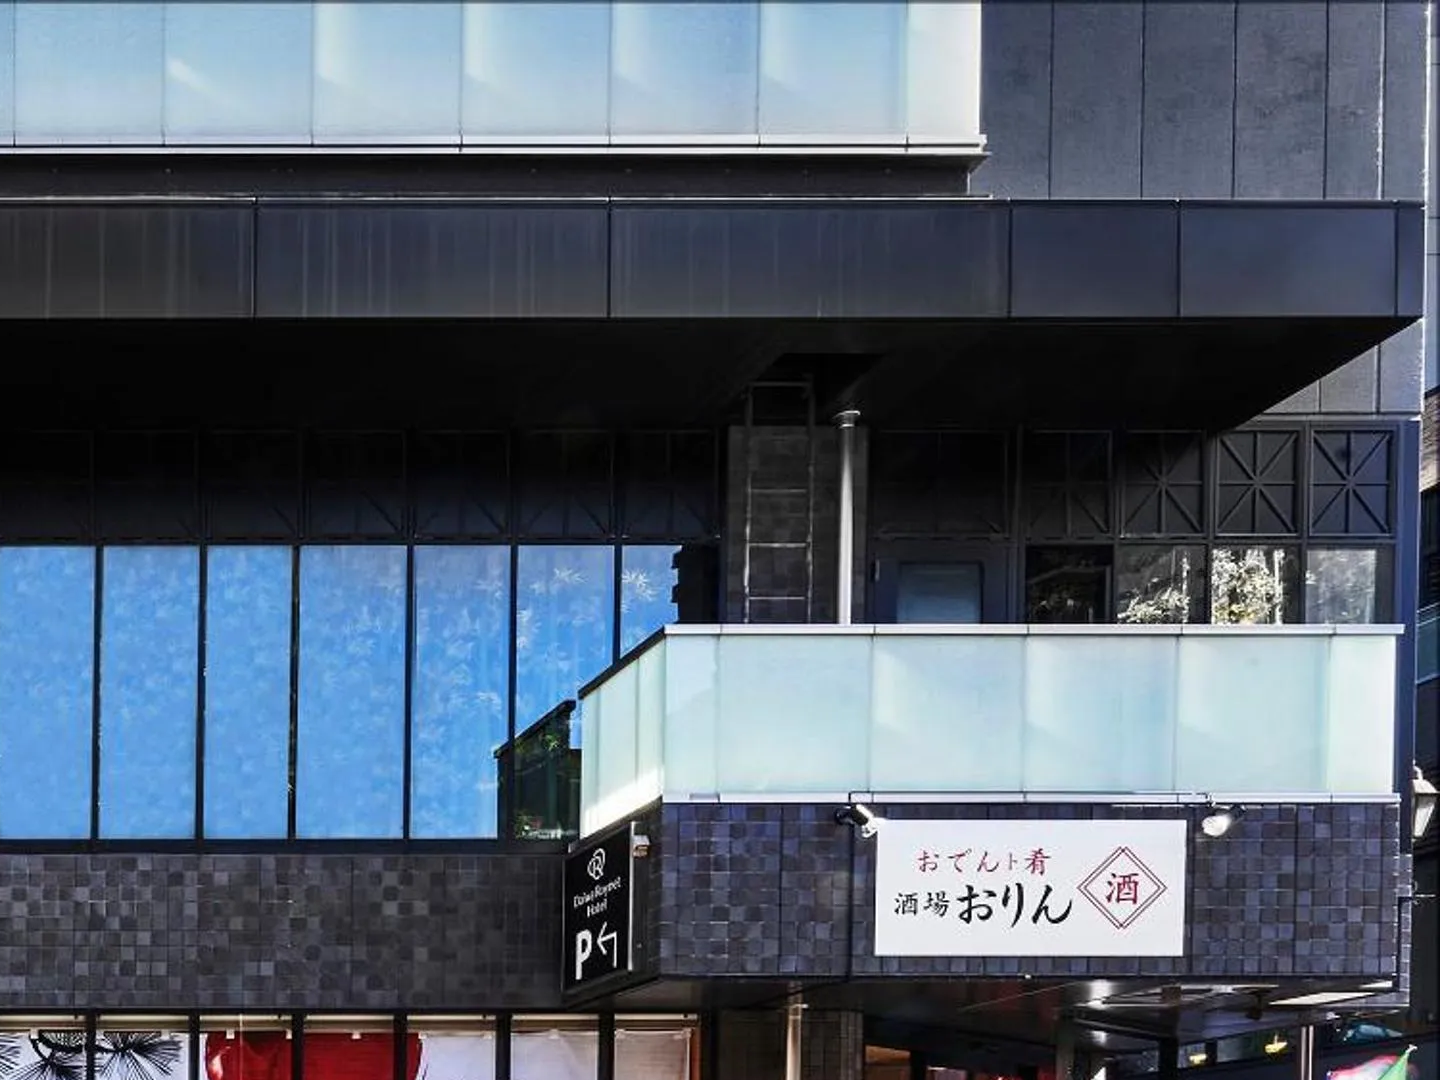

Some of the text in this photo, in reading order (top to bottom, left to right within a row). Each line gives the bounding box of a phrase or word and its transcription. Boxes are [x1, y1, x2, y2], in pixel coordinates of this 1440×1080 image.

[1106, 872, 1139, 905] 酒
[586, 898, 608, 918] Hotel
[575, 929, 593, 981] P
